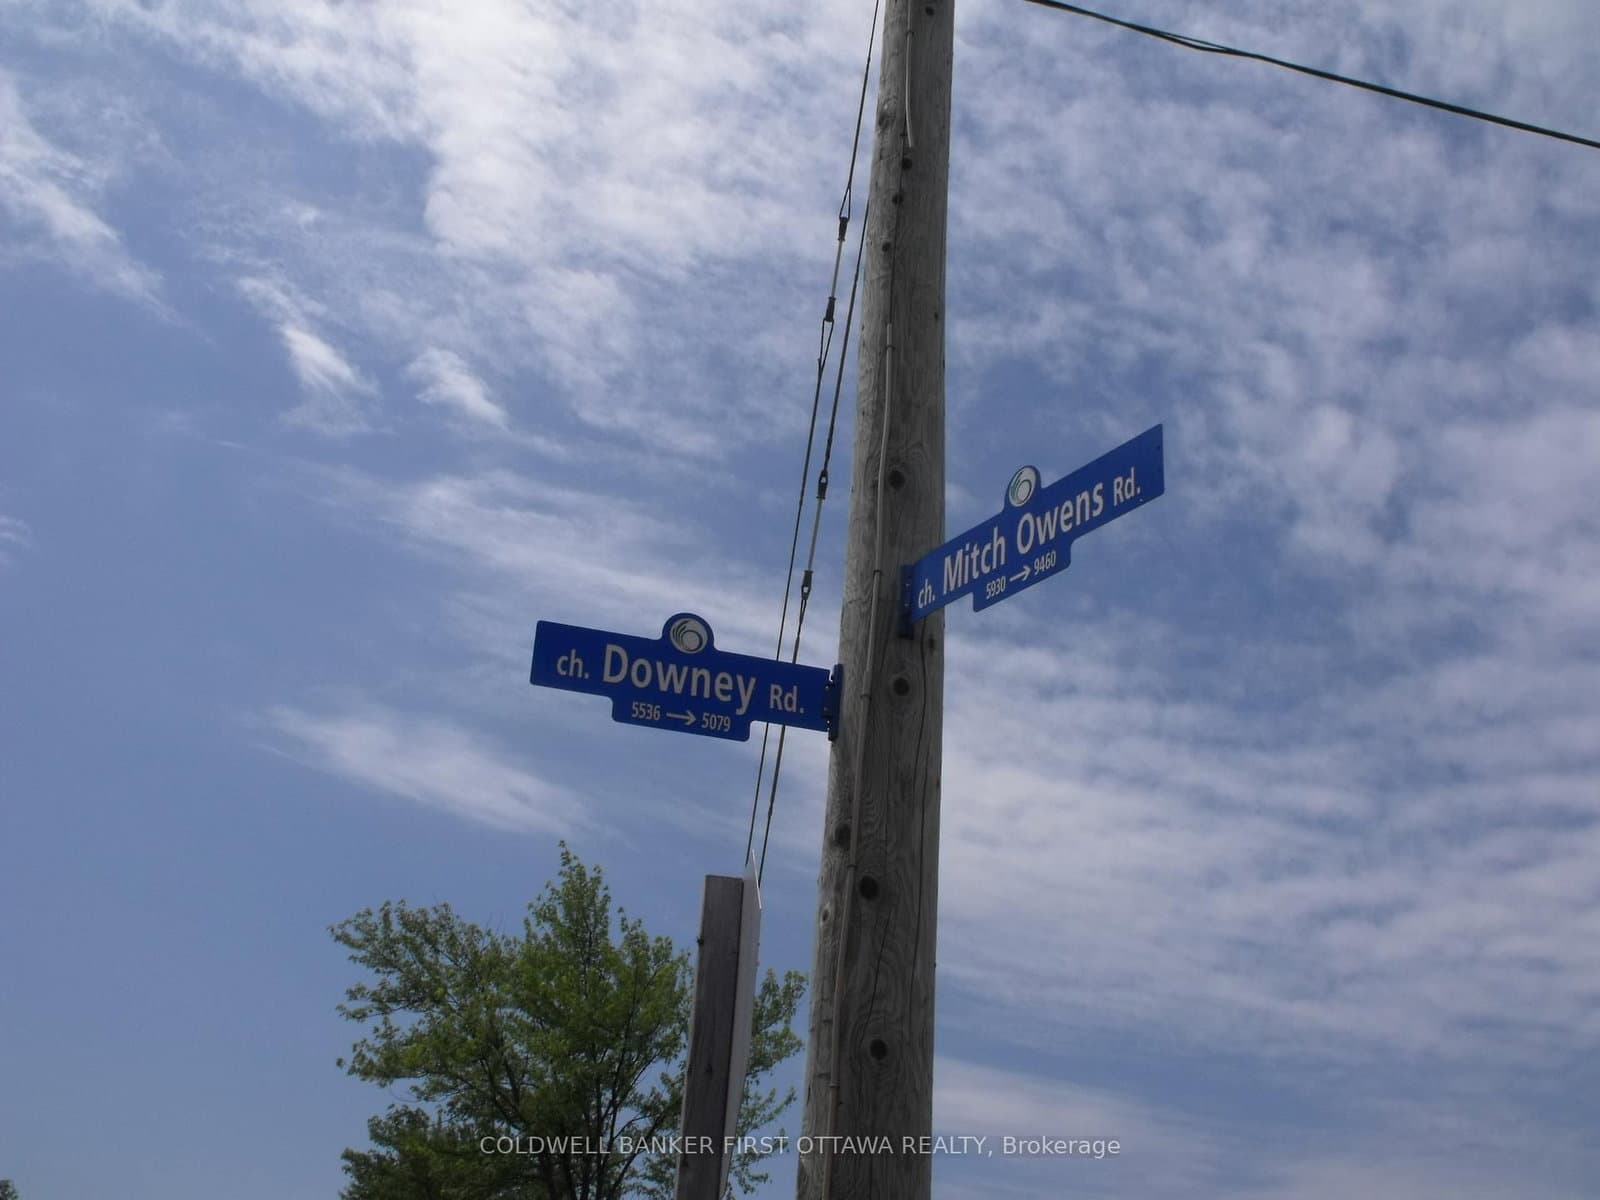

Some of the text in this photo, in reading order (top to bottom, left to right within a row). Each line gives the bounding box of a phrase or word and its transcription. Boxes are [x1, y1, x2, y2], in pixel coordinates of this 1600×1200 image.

[918, 466, 1141, 609] ch. Mitch Owens Rd.
[986, 550, 1057, 600] 5930 9460
[556, 644, 805, 715] ch. Downey Rd.
[631, 701, 731, 732] 5536 5079
